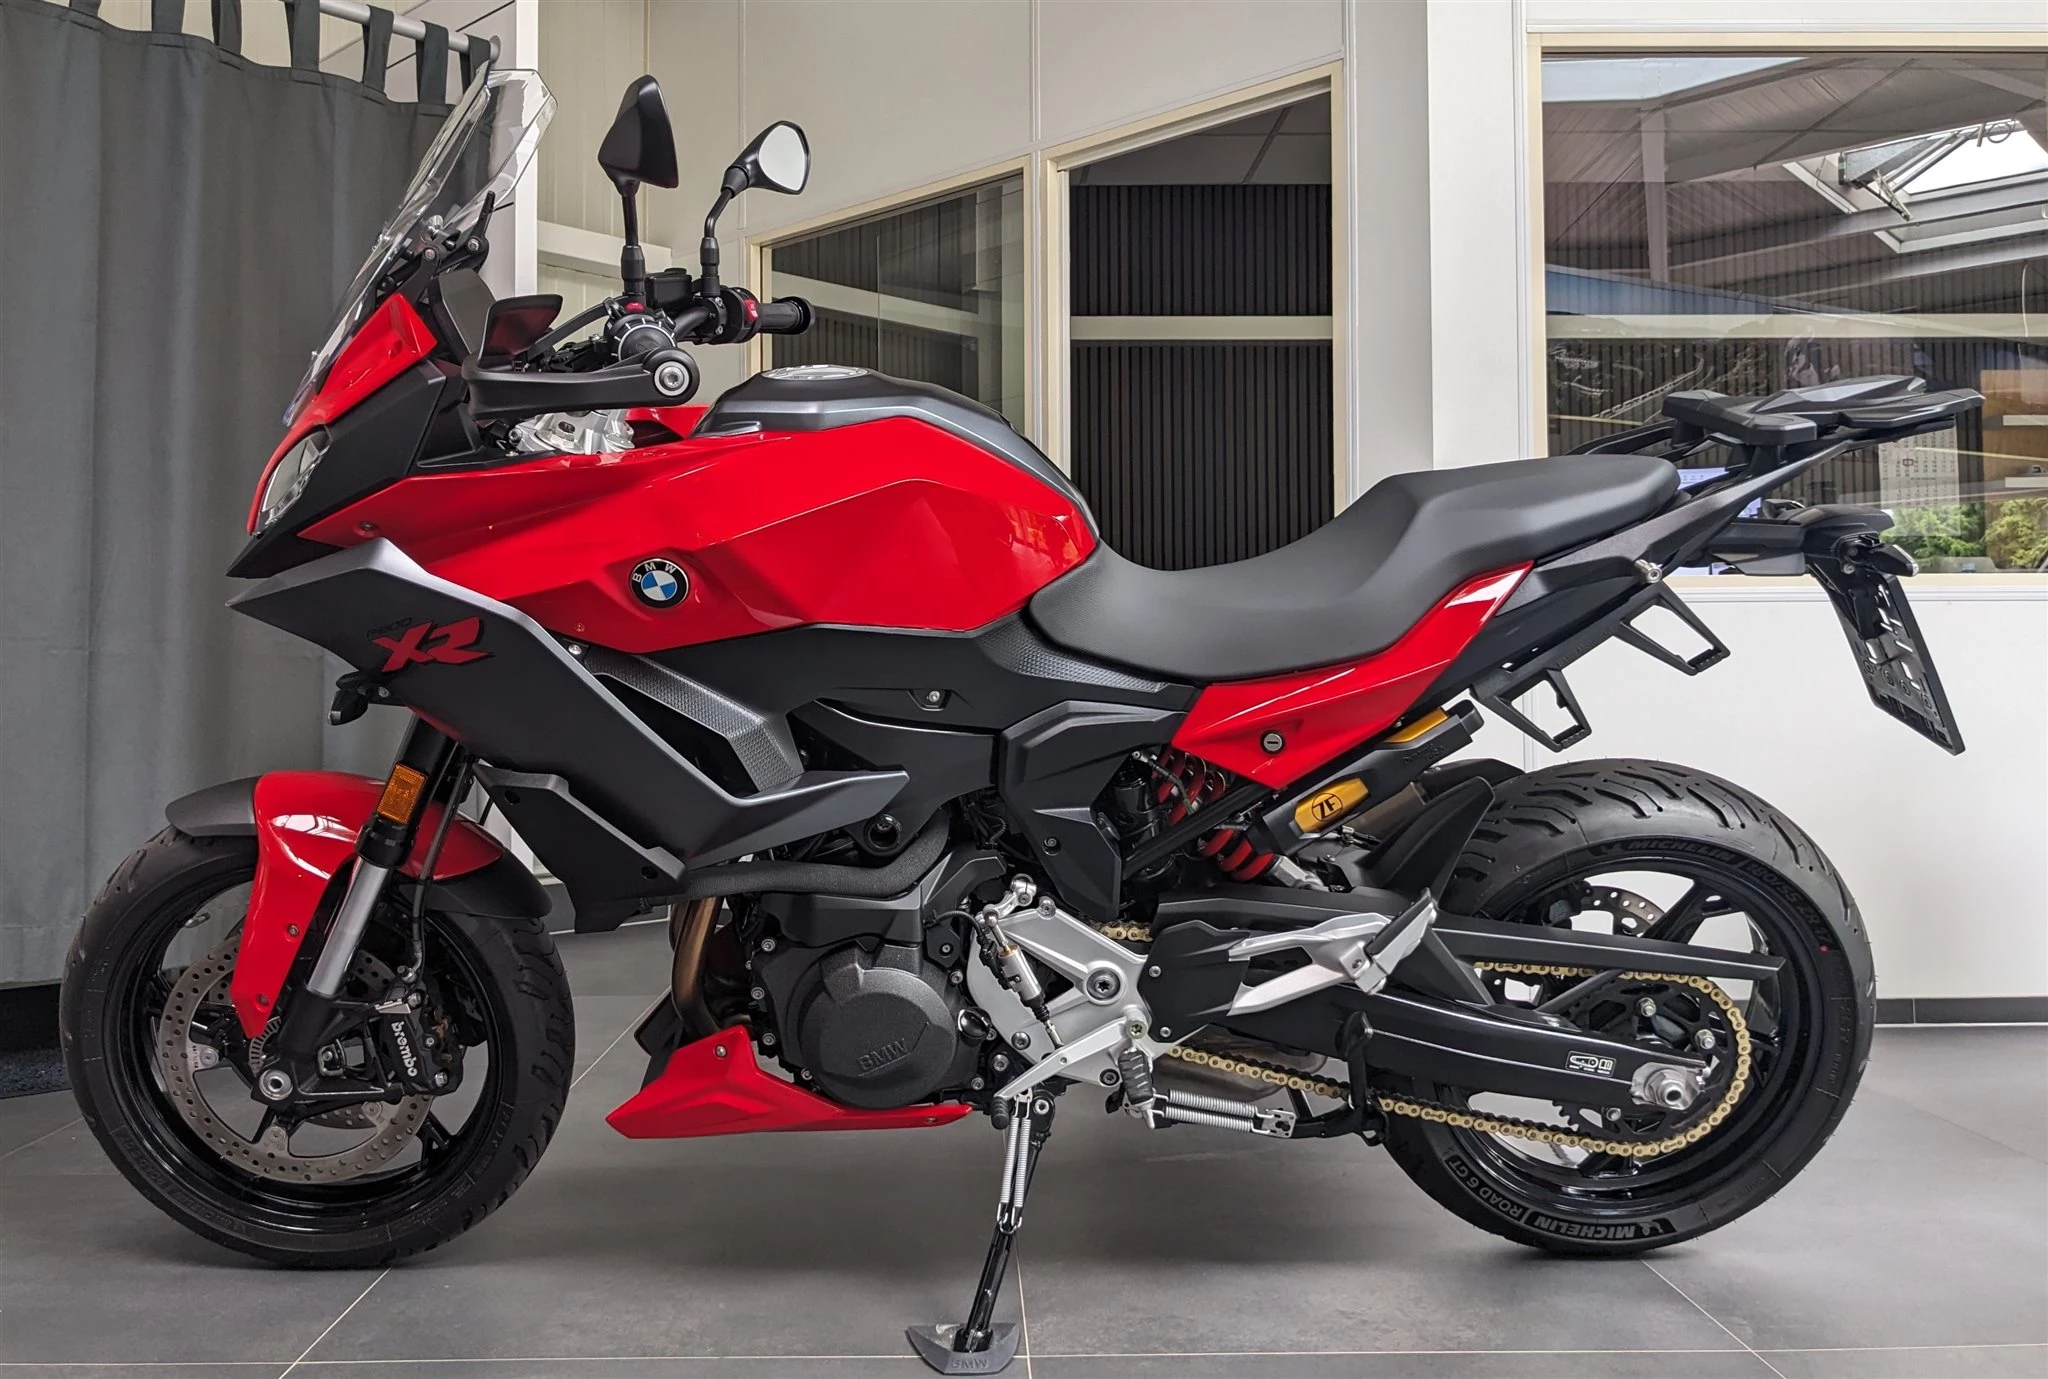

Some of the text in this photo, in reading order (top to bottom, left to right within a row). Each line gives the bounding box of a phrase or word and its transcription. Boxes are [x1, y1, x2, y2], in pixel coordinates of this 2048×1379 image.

[632, 562, 677, 583] BMW
[1312, 795, 1342, 821] ZF
[391, 1021, 418, 1077] brembo
[857, 1037, 908, 1070] BMW
[1449, 1160, 1636, 1239] MICHELIN ROAD 6 GT
[951, 1359, 989, 1369] BMW
